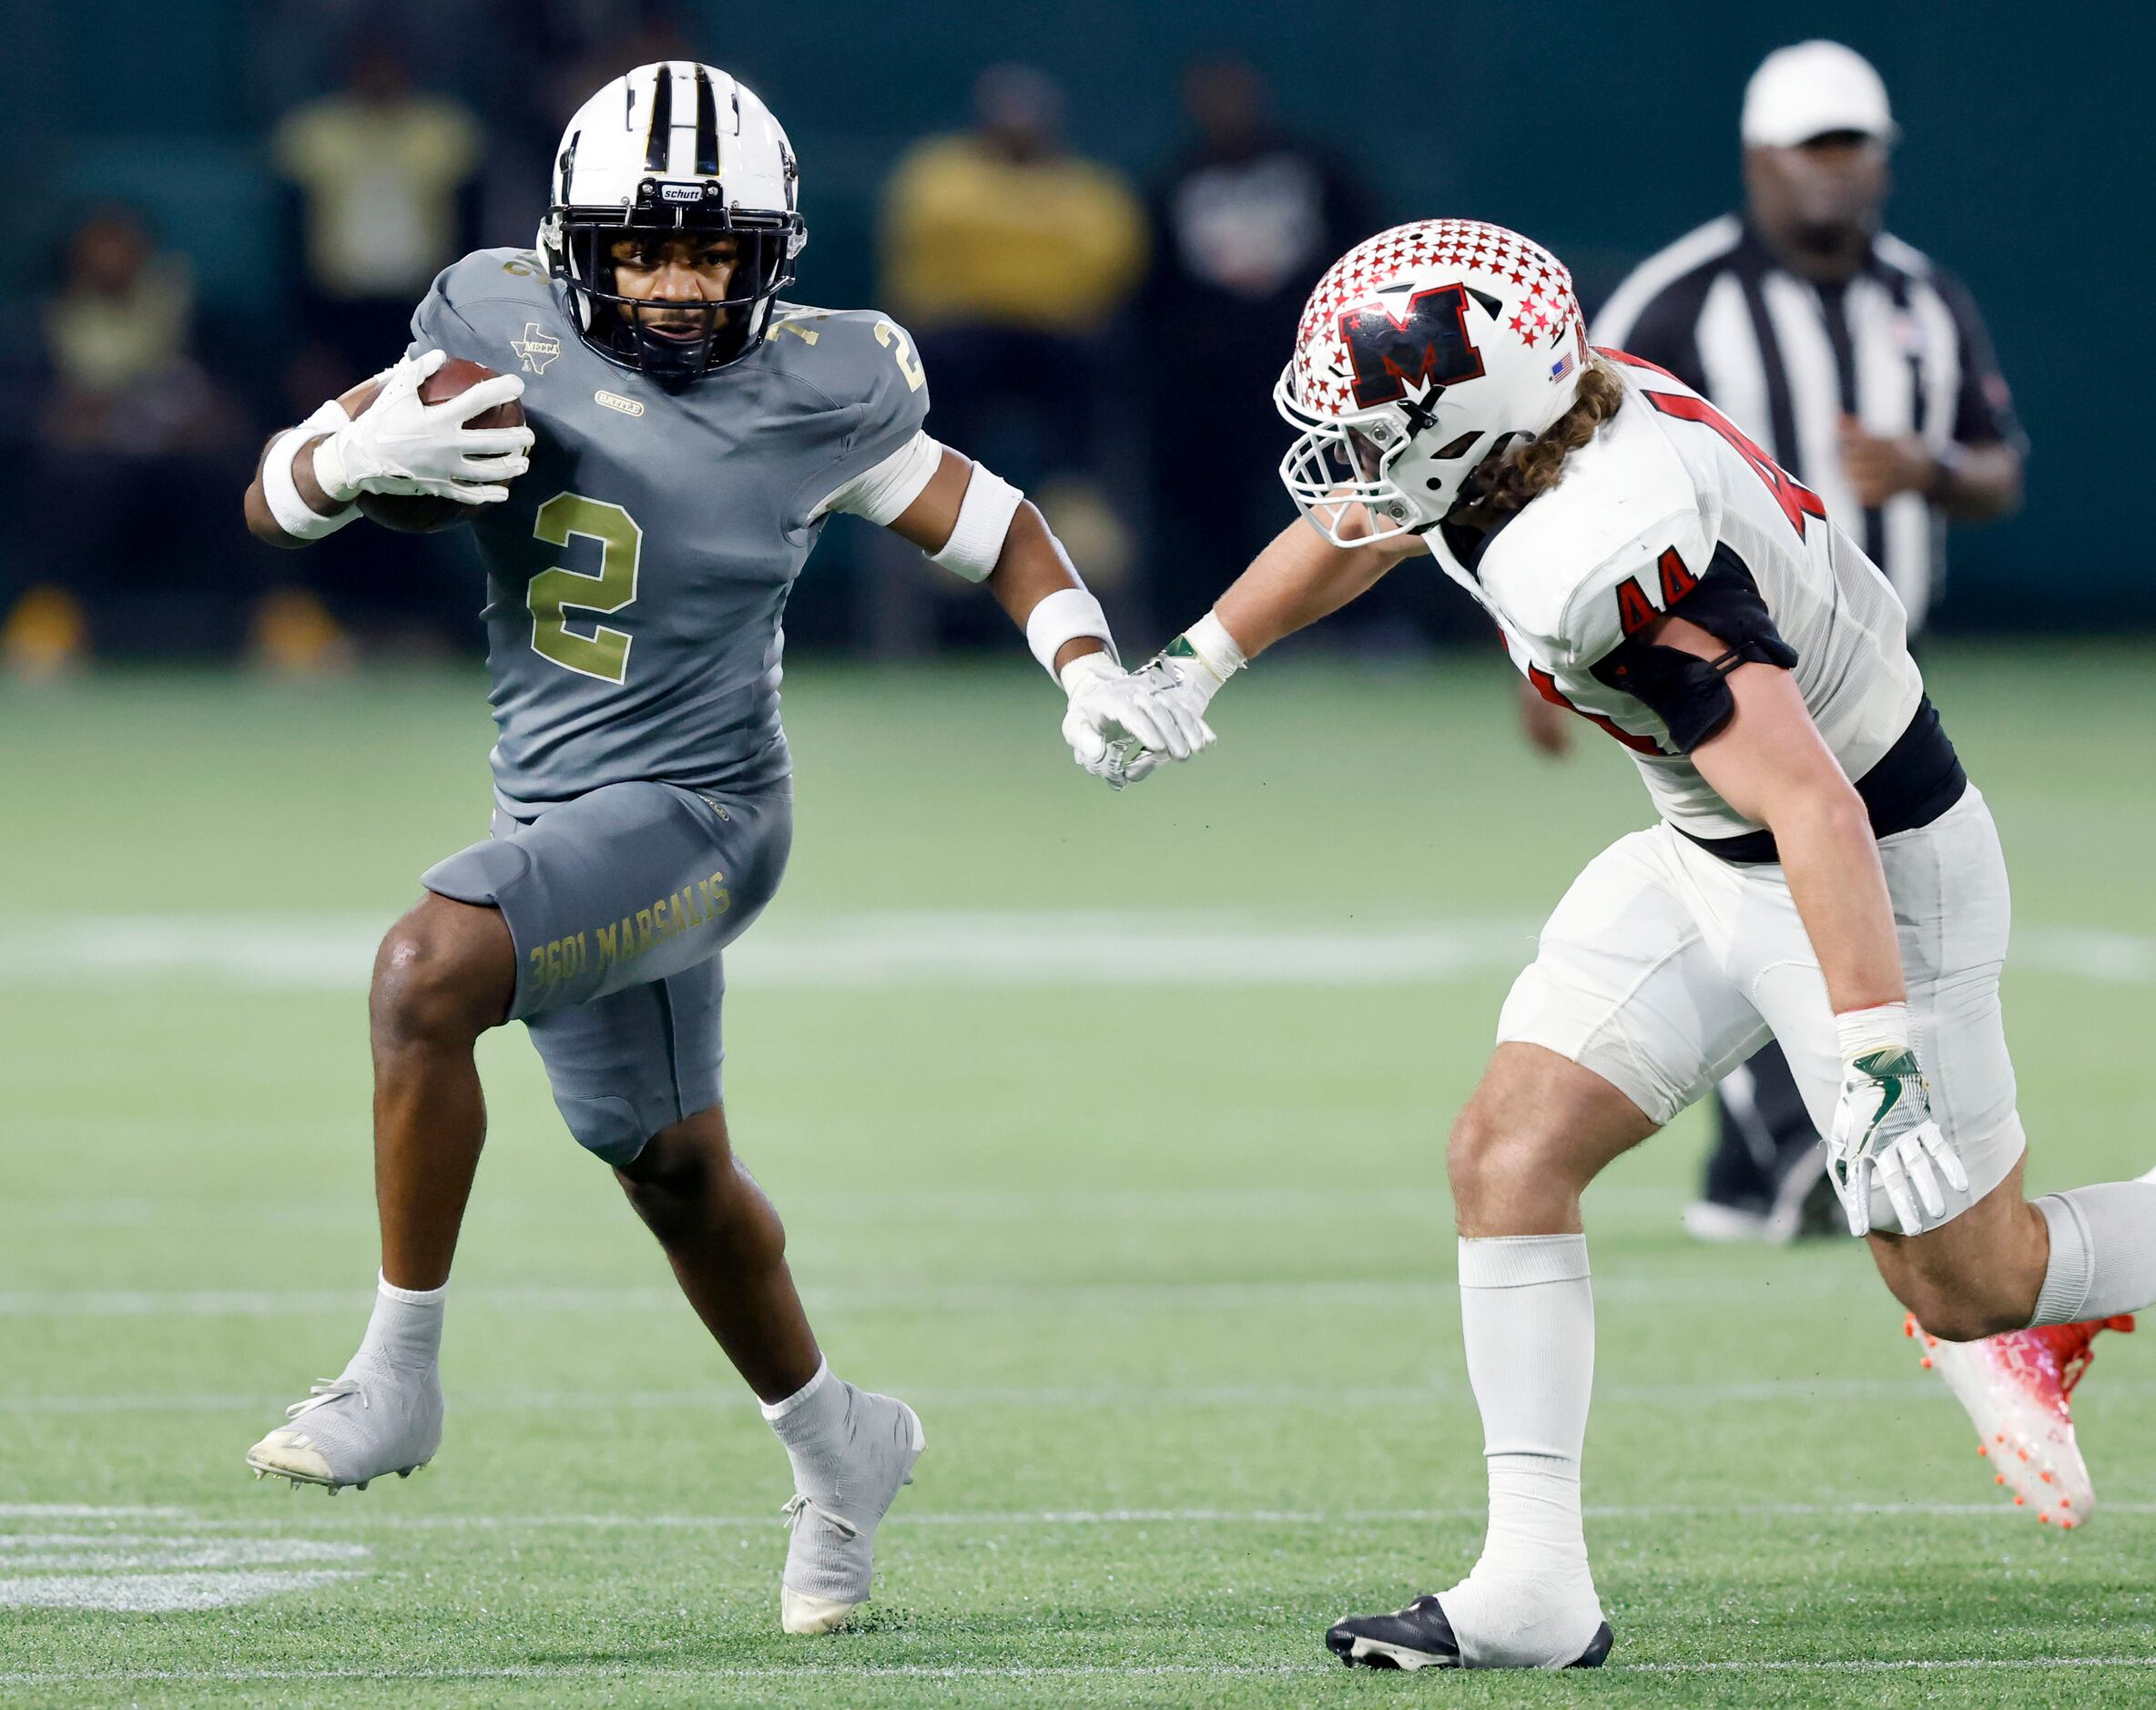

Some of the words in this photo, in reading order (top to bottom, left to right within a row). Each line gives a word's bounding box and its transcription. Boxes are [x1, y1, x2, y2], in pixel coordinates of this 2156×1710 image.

[665, 188, 699, 199] schutt
[524, 341, 559, 354] MECCA
[874, 320, 926, 393] 2
[1338, 282, 1486, 410] M
[597, 392, 642, 414] BATTLE
[526, 491, 643, 686] 2
[1615, 545, 1700, 636] 44
[526, 931, 587, 992] 3601
[596, 871, 730, 972] MARSALIS
